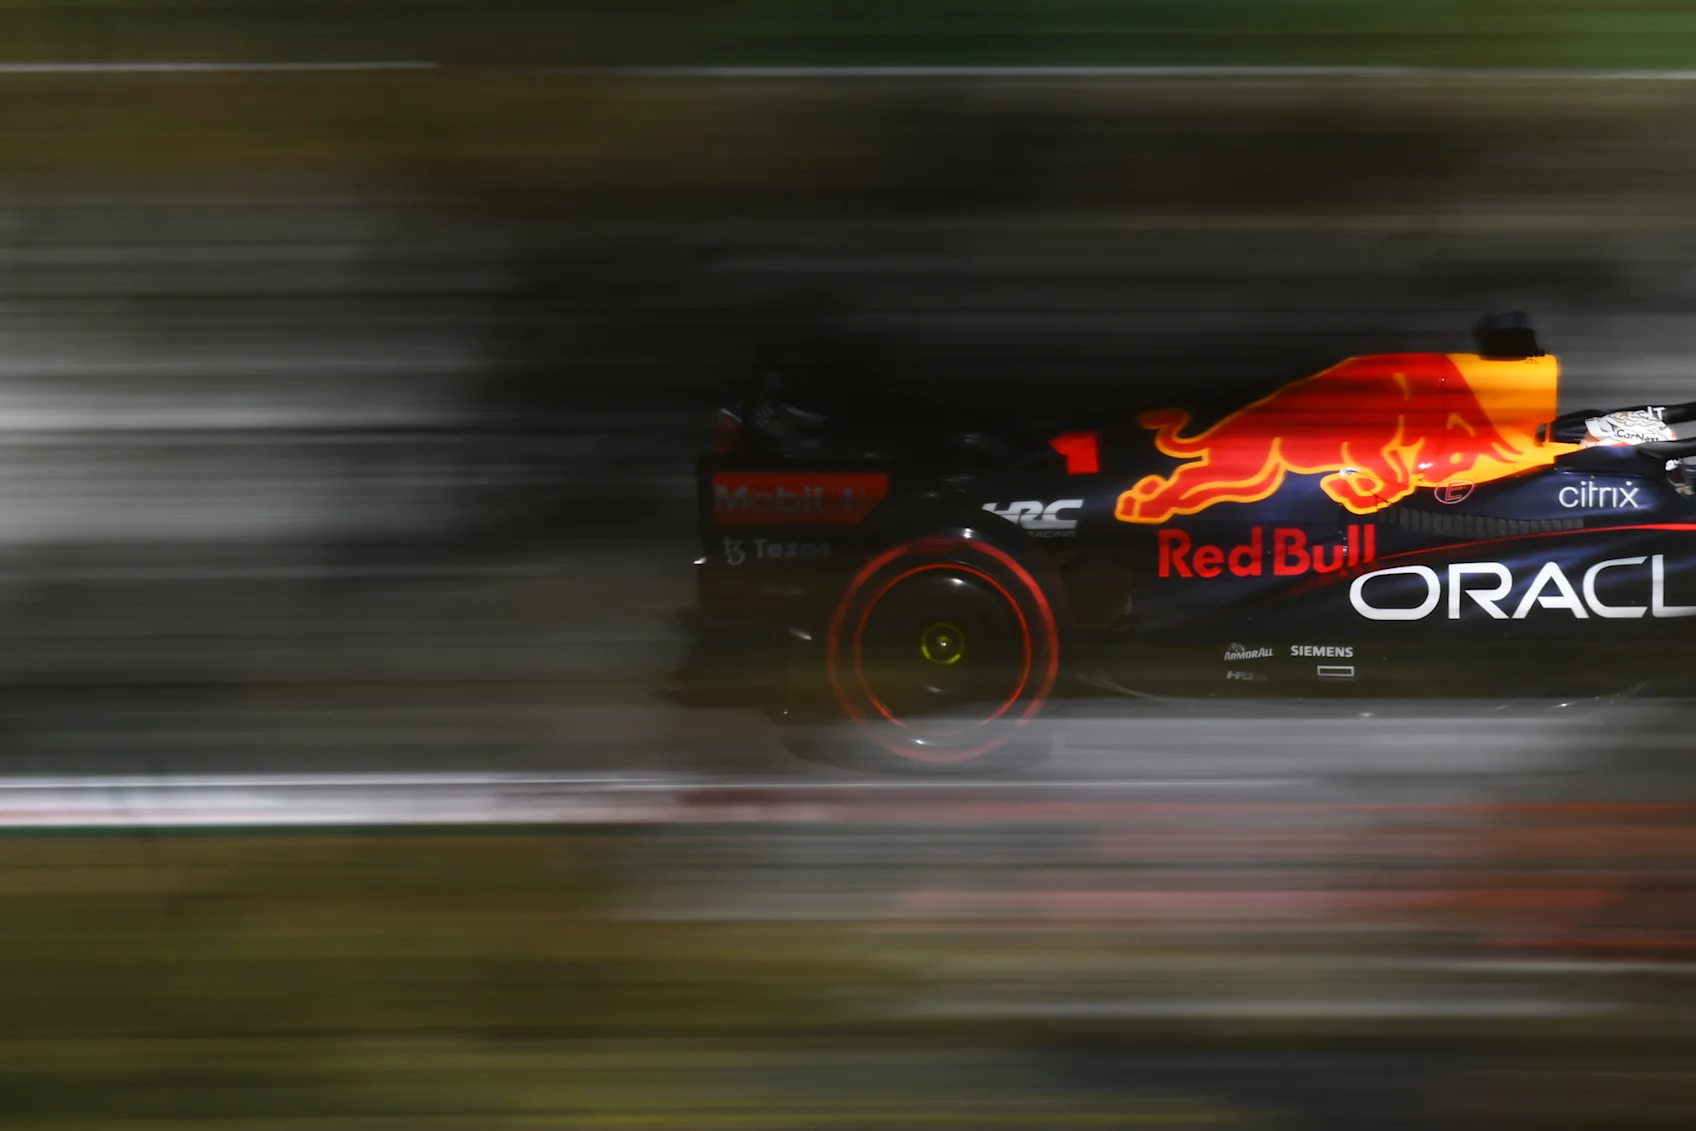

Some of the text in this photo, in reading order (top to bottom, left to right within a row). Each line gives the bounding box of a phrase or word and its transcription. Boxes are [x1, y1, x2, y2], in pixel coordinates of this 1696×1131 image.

[714, 484, 824, 512] Mobil
[1558, 480, 1639, 508] citrix
[752, 537, 833, 560] Tezos
[1158, 524, 1376, 578] Red Bull
[1290, 645, 1354, 658] SIEMENS
